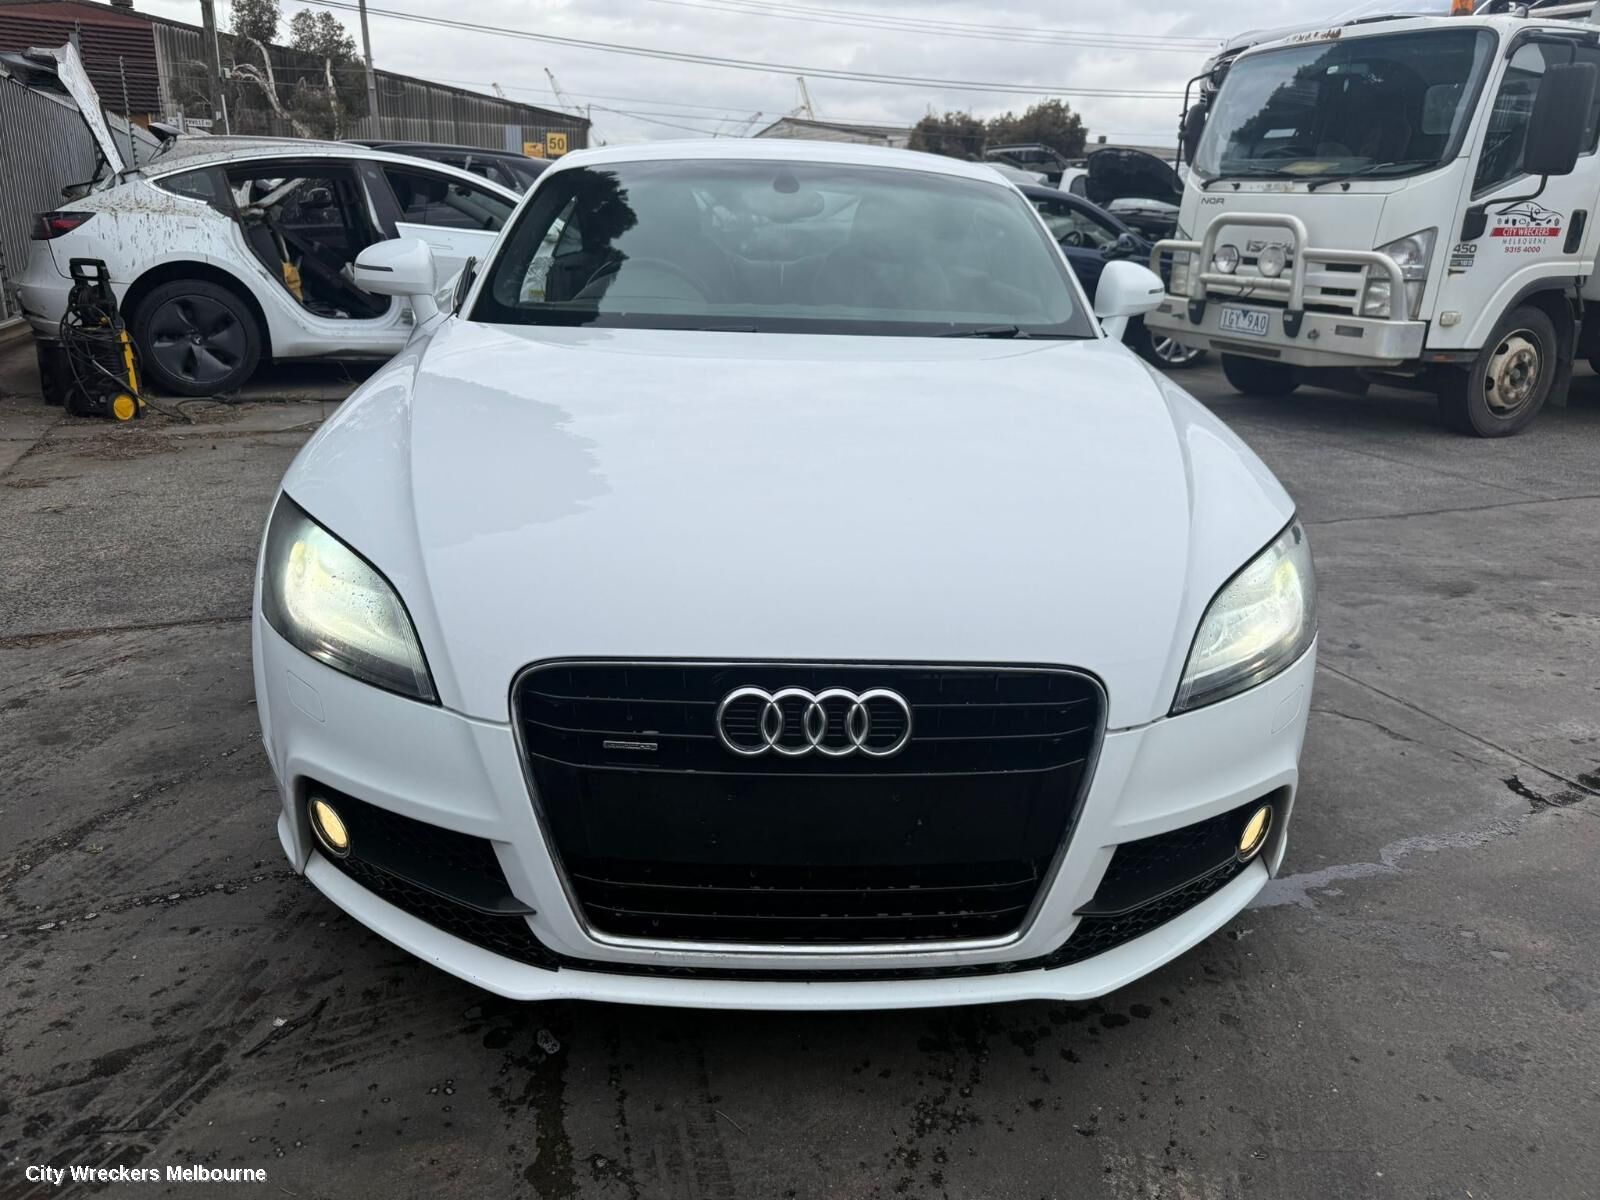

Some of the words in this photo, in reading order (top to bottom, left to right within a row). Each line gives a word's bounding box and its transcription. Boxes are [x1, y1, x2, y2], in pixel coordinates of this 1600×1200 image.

[549, 137, 565, 151] 50
[1502, 227, 1517, 236] CITY
[1518, 227, 1550, 236] WRECKERS
[1453, 243, 1478, 254] 450
